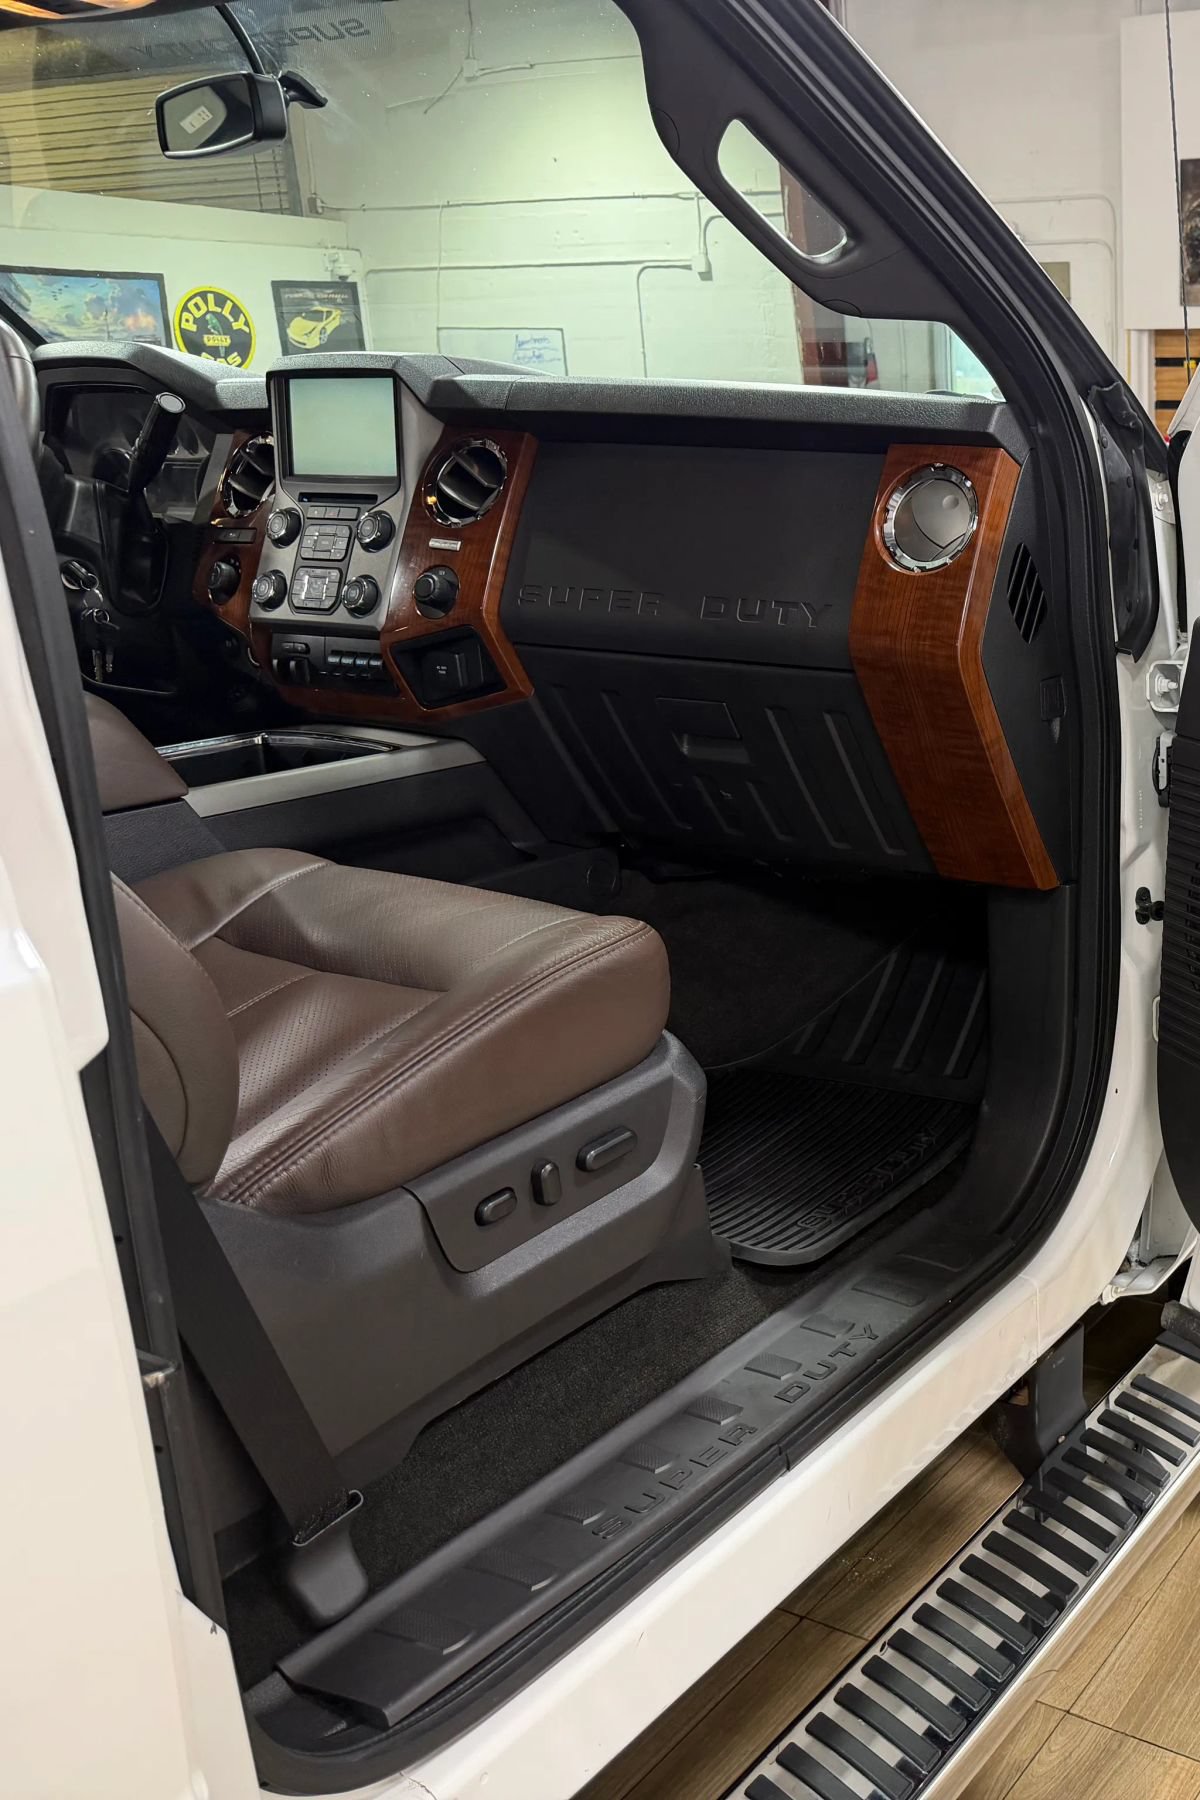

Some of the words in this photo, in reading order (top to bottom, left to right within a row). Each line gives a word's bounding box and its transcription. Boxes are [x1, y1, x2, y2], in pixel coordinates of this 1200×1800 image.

[181, 293, 250, 334] POLLY
[518, 584, 664, 616] SUPER
[700, 595, 833, 628] DUTY
[592, 1424, 758, 1540] SUPER
[773, 1323, 879, 1404] DUTY
